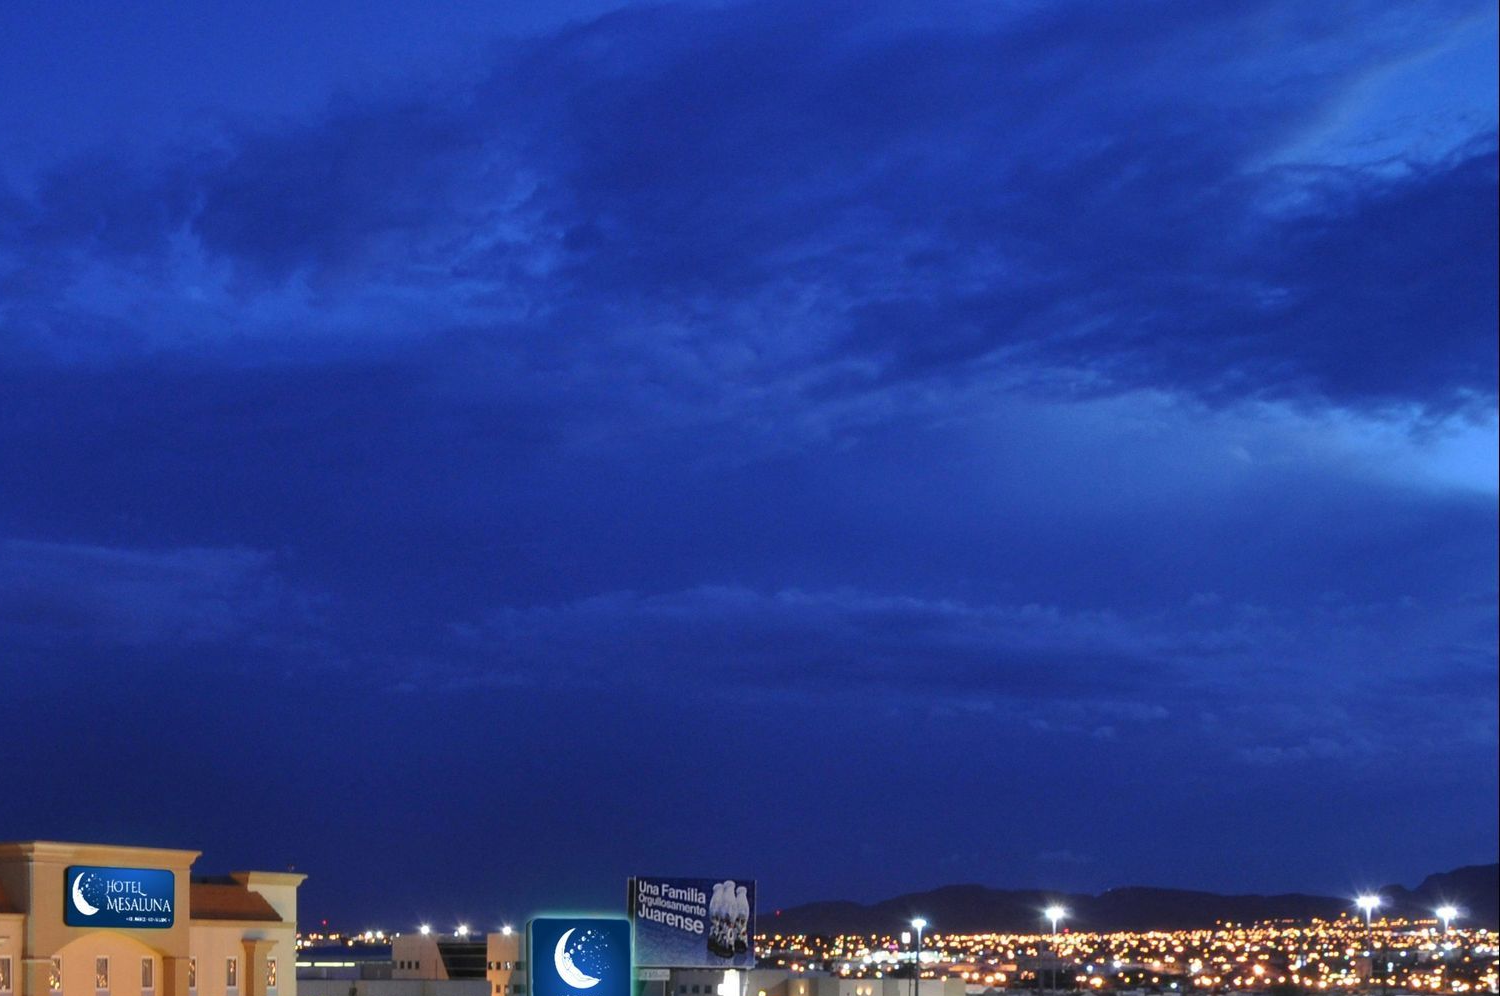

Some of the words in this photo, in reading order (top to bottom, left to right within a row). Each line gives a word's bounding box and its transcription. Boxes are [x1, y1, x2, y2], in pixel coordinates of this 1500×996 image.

[106, 880, 147, 896] HOTEL
[639, 881, 659, 894] Una
[662, 884, 706, 904] Familia
[106, 896, 171, 913] MESALUNA
[638, 893, 707, 918] Orgullosamente
[638, 904, 704, 933] Juarense
